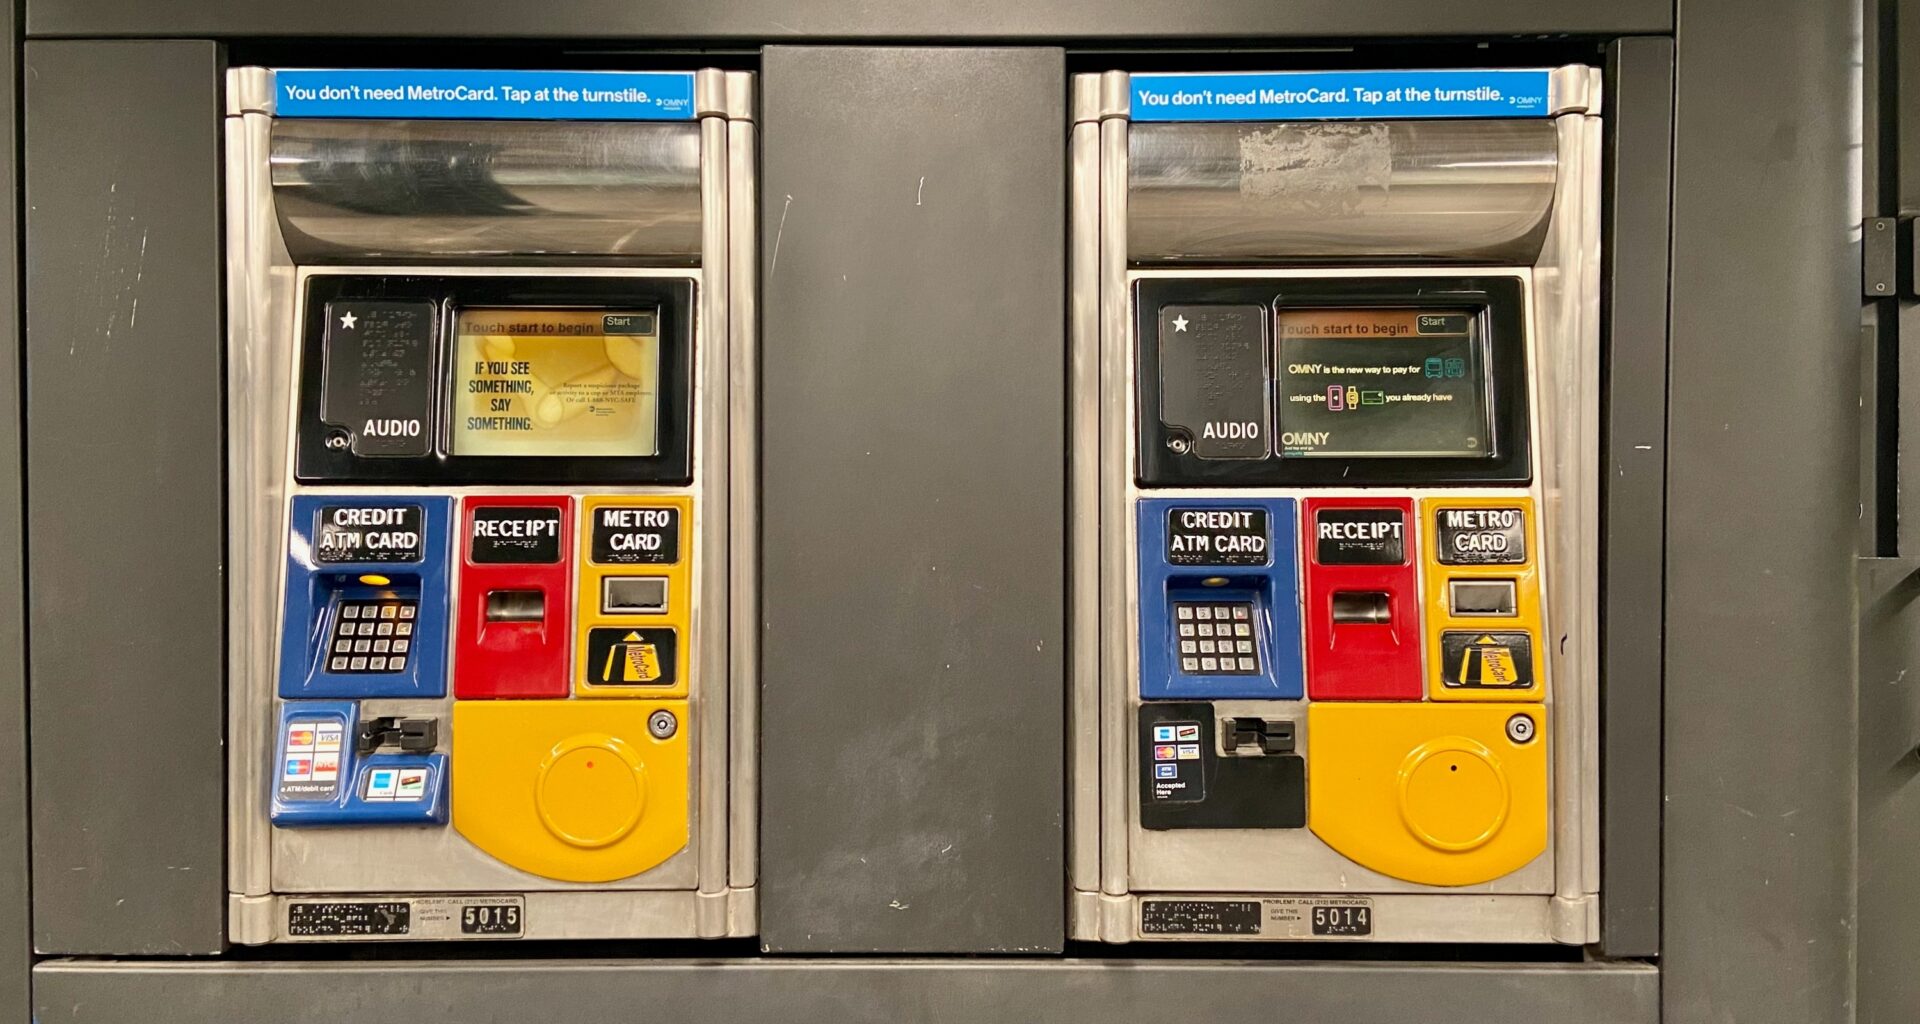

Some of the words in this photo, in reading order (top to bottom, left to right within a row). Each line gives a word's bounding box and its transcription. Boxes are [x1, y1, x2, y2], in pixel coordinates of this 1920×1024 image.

[285, 85, 316, 100] You
[319, 85, 360, 100] don't
[363, 85, 404, 100] need
[407, 86, 498, 101] MetroCard.
[501, 86, 531, 103] Tap
[534, 87, 549, 101] at
[553, 87, 579, 101] the
[582, 88, 651, 103] turnstile.
[663, 98, 688, 106] OMNY
[1138, 90, 1168, 105] You
[1172, 90, 1212, 105] don't
[1215, 90, 1255, 104] need
[1259, 88, 1349, 104] MetroCard.
[1353, 87, 1382, 104] Tap
[1386, 88, 1401, 102] at
[1405, 87, 1431, 101] the
[1434, 86, 1504, 101] turnstile.
[1516, 96, 1543, 104] OMNY
[465, 322, 504, 333] Touch
[509, 323, 538, 332] start
[542, 323, 554, 332] to
[558, 322, 593, 335] begin
[607, 316, 631, 326] Start
[1323, 324, 1352, 334] start
[1356, 324, 1368, 334] to
[1373, 323, 1408, 336] begin
[1421, 317, 1445, 326] Start
[475, 362, 484, 375] IF
[487, 362, 507, 375] YOU
[511, 361, 530, 375] SEE
[1288, 364, 1322, 374] OMNY
[1323, 366, 1330, 374] is
[1332, 366, 1345, 374] the
[1364, 367, 1381, 375] way
[1382, 366, 1391, 374] to
[1392, 367, 1407, 375] pay
[1408, 365, 1420, 374] for
[468, 380, 534, 395] SOMETHING,
[490, 399, 512, 412] SAY
[1290, 395, 1312, 403] using
[1313, 394, 1326, 402] the
[1385, 395, 1400, 403] you
[1402, 394, 1431, 403] already
[1432, 394, 1453, 402] have
[363, 419, 421, 437] AUDIO
[467, 417, 533, 431] SOMETHING.
[1202, 421, 1259, 439] AUDIO
[1281, 432, 1330, 446] OMNY
[334, 508, 407, 526] CREDIT
[603, 510, 670, 528] METRO
[1181, 511, 1253, 529] CREDIT
[1447, 510, 1514, 528] METRO
[474, 520, 559, 537] RECEIPT
[1318, 522, 1402, 540] RECEIPT
[319, 532, 360, 550] ATM
[366, 531, 418, 550] CARD
[609, 533, 661, 551] CARD
[1171, 534, 1209, 552] ATM
[1214, 535, 1266, 553] CARD
[1455, 534, 1507, 552] CARD
[465, 907, 518, 925] 5015
[1316, 908, 1367, 926] 5014
